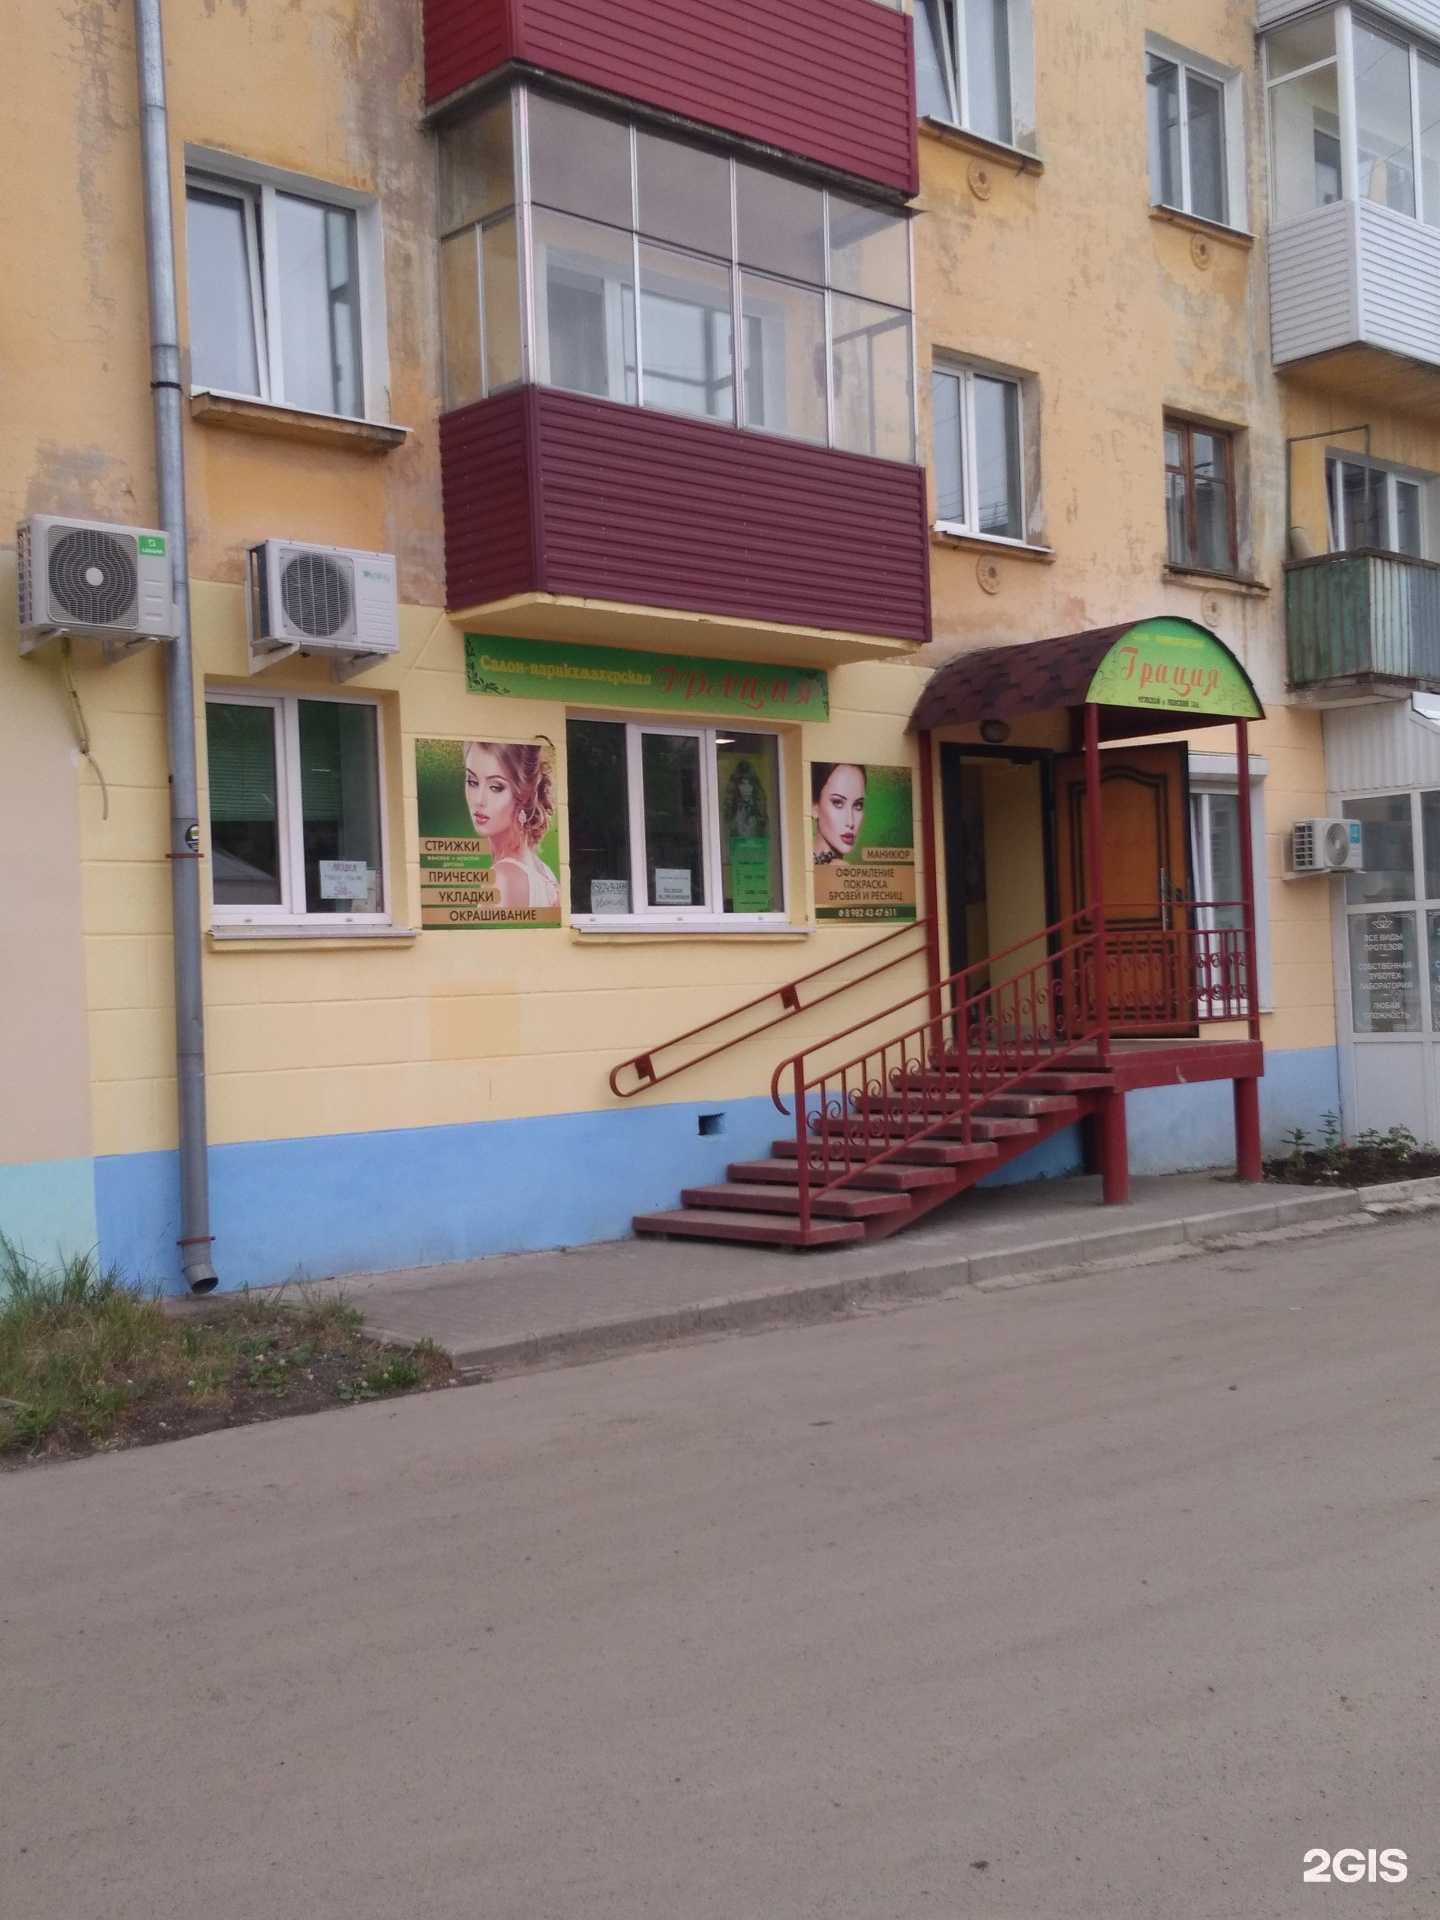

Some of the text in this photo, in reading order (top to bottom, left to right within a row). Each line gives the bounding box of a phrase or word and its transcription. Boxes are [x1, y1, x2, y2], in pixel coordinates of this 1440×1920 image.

[1119, 645, 1221, 698] Грация
[656, 665, 820, 710] Грация
[424, 839, 481, 852] СТРИЖКИ
[866, 849, 911, 860] МАНИКЮР
[428, 871, 490, 883] ПРИЧЕСКИ
[835, 867, 895, 879] ОФОРМЛЕНИЕ
[842, 879, 889, 890] ПОКРАСКА
[438, 891, 495, 904] УКЛАДКИ
[828, 890, 903, 902] БРОВЕЙ И РЕСНИЦ
[449, 909, 537, 922] ОКРАШИВАНИЕ
